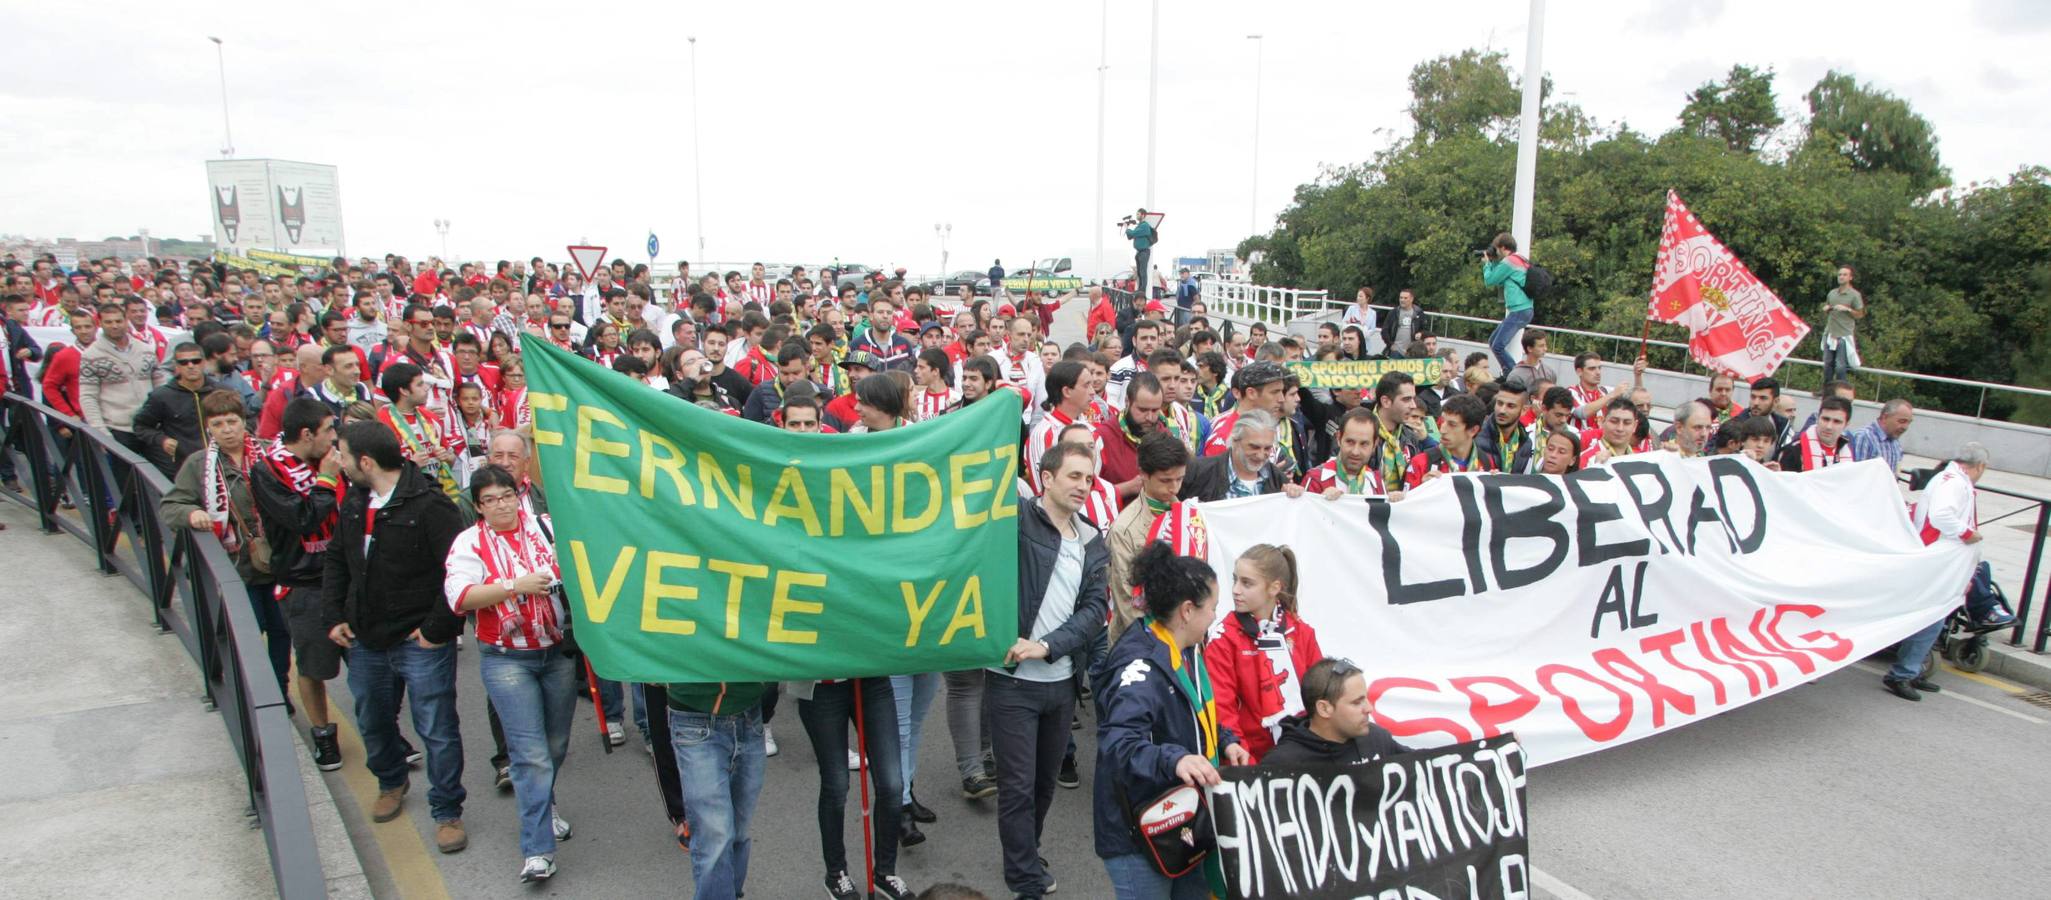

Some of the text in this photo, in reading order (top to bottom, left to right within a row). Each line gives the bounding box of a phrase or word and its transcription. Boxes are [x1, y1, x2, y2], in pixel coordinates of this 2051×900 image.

[1310, 359, 1424, 375] SPORTING SOMOS
[1316, 373, 1426, 388] NOSOTS
[527, 391, 1018, 537] FERNÁNDEZ
[1366, 456, 1768, 605] LIBERAD
[570, 540, 827, 645] VETE
[899, 575, 986, 648] YA
[1591, 560, 1658, 639] AL
[1366, 603, 1854, 745] SPORTING
[1147, 813, 1186, 834] Sporting
